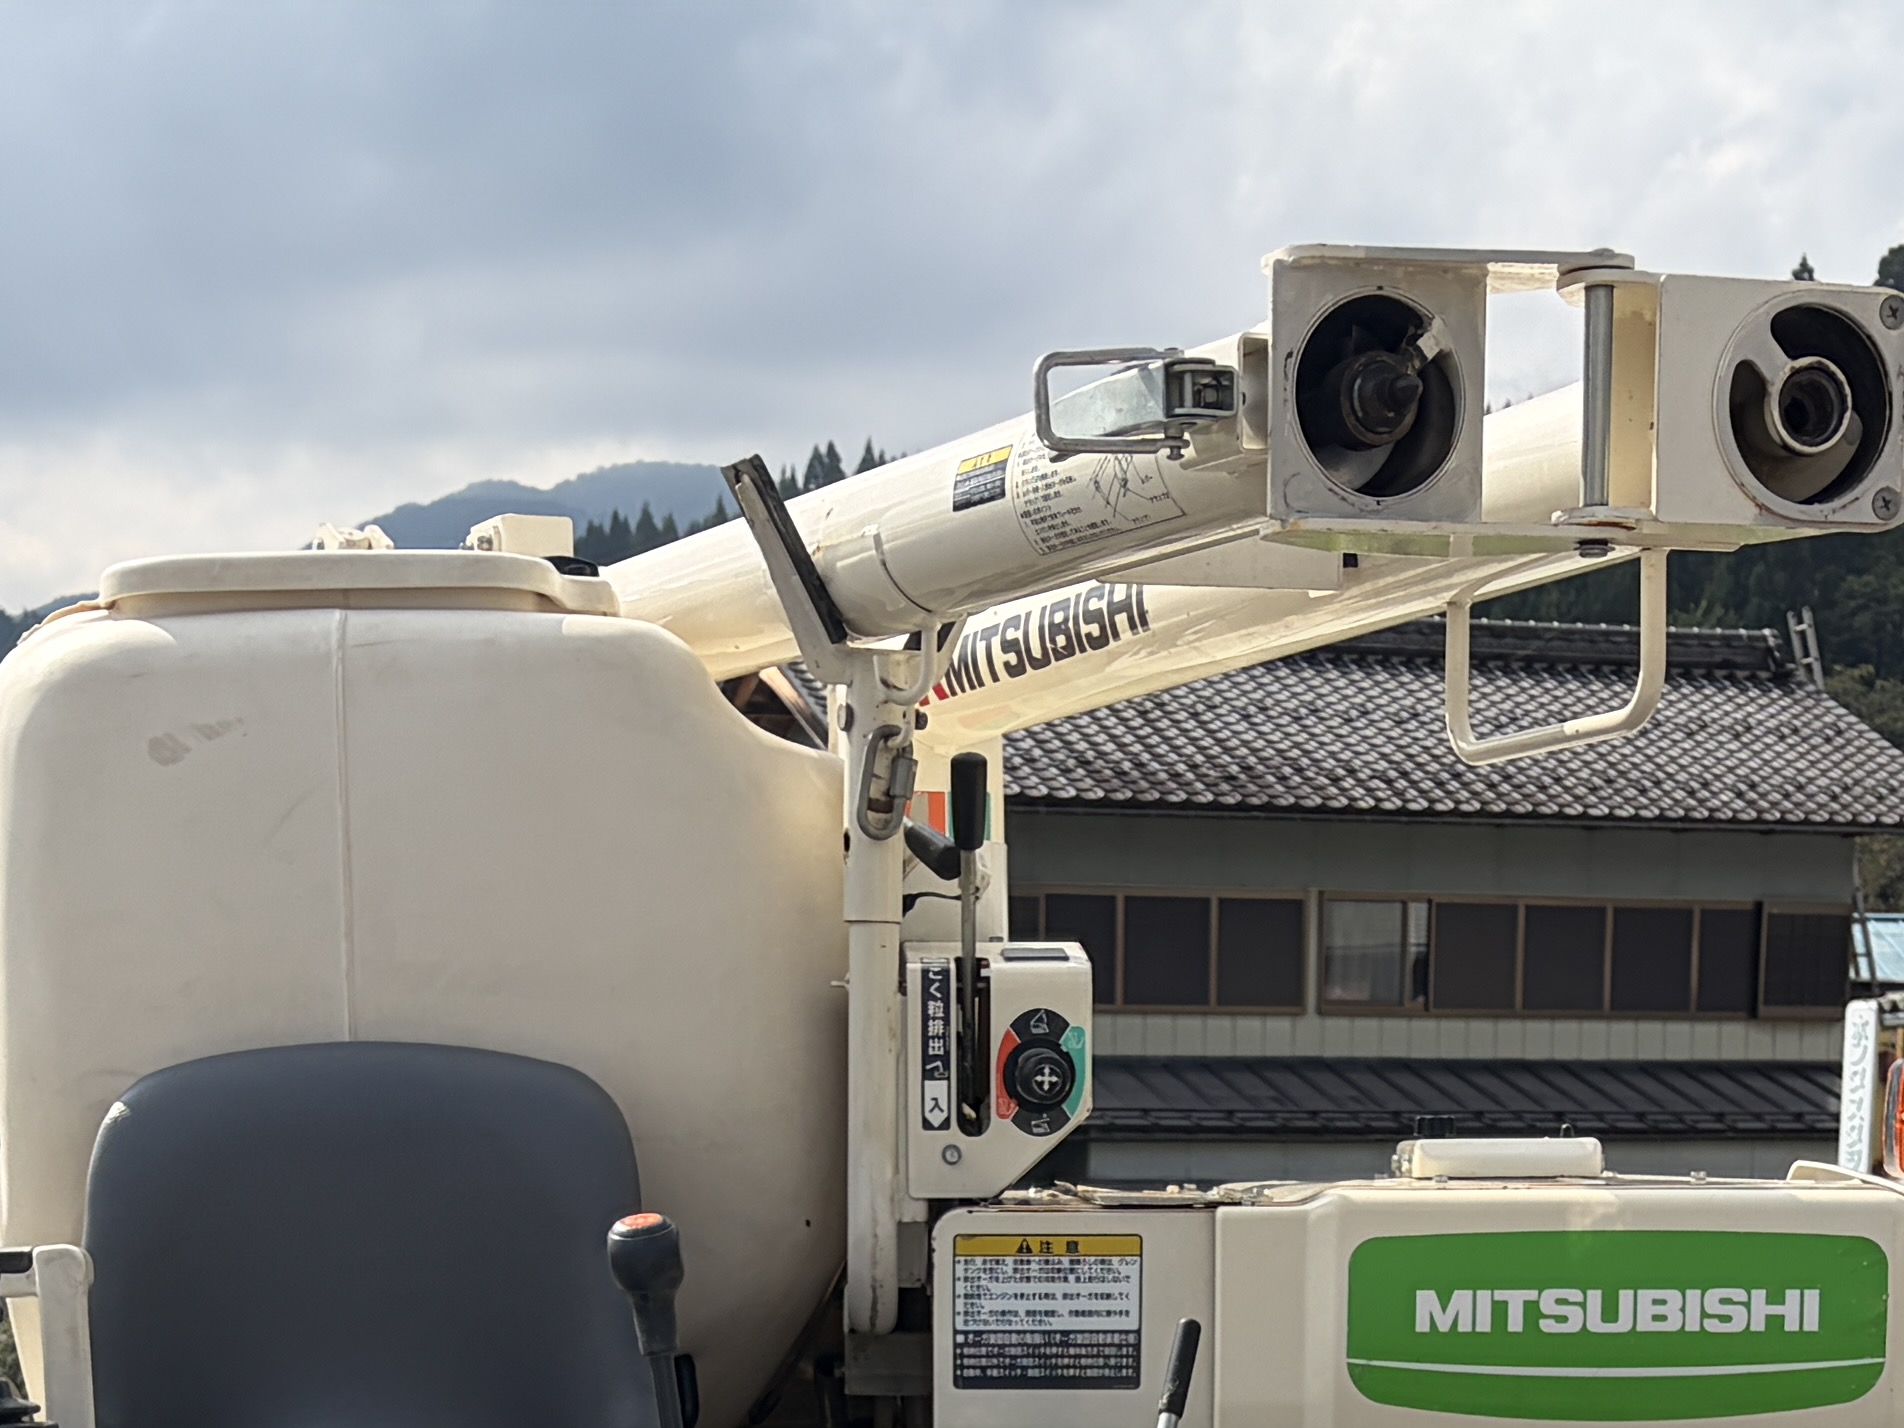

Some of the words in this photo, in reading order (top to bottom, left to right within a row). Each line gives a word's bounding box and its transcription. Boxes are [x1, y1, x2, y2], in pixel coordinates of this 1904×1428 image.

[945, 584, 1151, 697] MITSUBISHI
[927, 967, 945, 1056] こく粒排出
[928, 1097, 945, 1114] 入
[1415, 1288, 1820, 1333] MITSUBISHI
